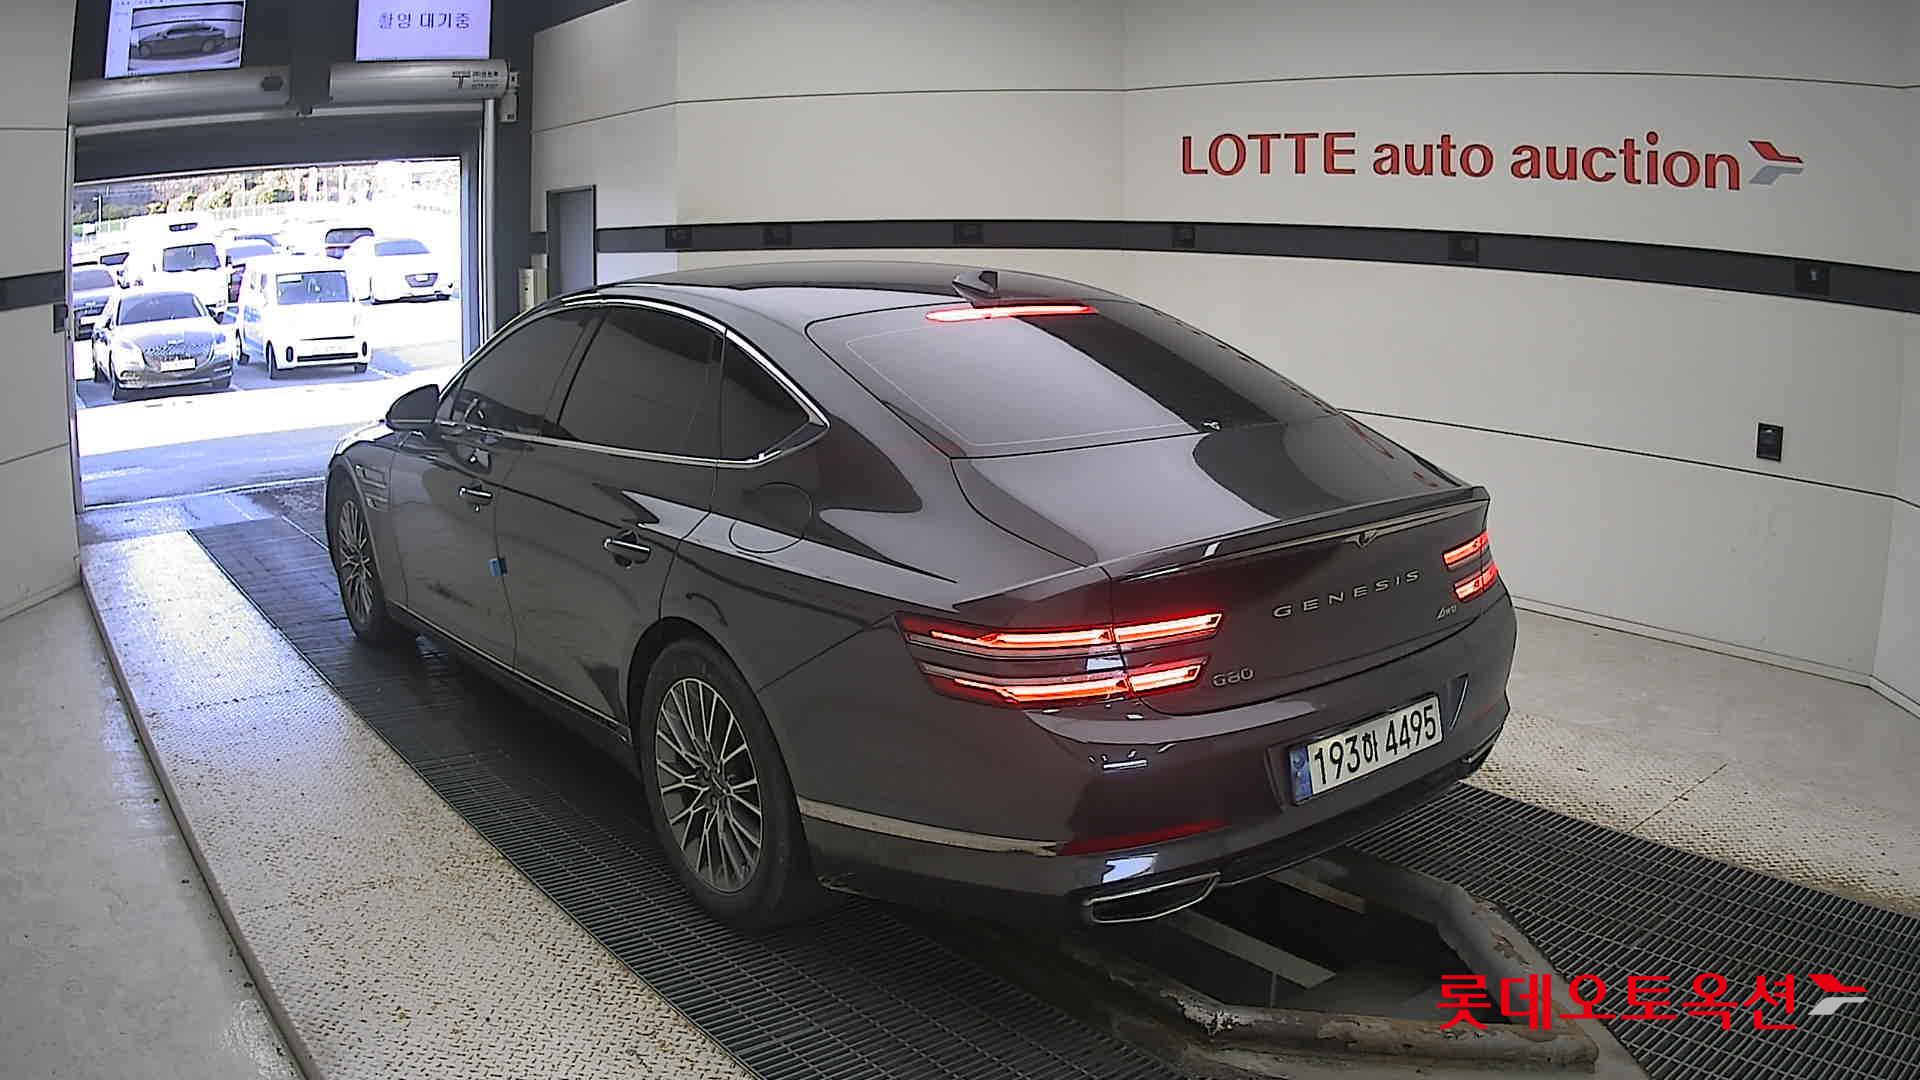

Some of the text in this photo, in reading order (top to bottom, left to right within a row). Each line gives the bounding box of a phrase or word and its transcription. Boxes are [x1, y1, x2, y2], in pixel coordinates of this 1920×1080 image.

[420, 12, 470, 30] 대기중
[1181, 131, 1741, 190] LOTTE auto auction
[1273, 568, 1421, 617] GENESIS
[1212, 666, 1255, 687] G80
[1385, 704, 1437, 756] 4495
